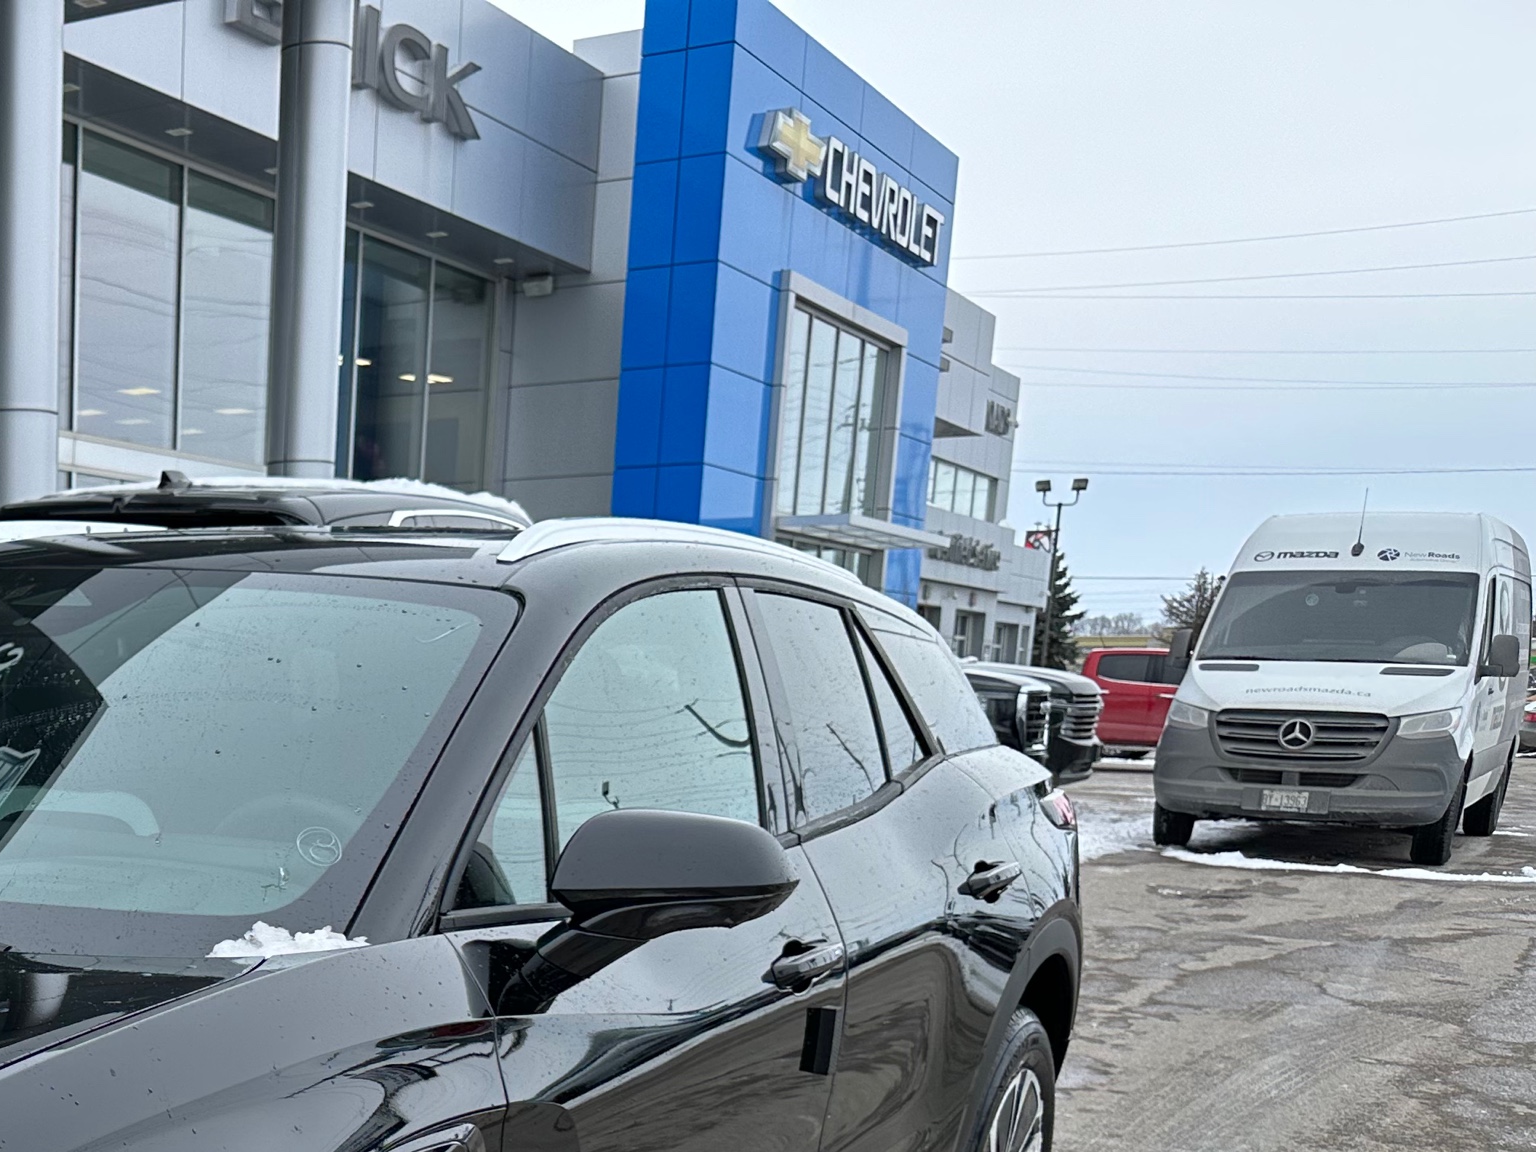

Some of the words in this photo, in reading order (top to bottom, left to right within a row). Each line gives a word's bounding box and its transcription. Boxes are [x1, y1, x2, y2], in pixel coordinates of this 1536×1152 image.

[825, 135, 945, 267] CHEVROLET
[1277, 551, 1339, 559] mazda
[1428, 552, 1460, 560] Roads
